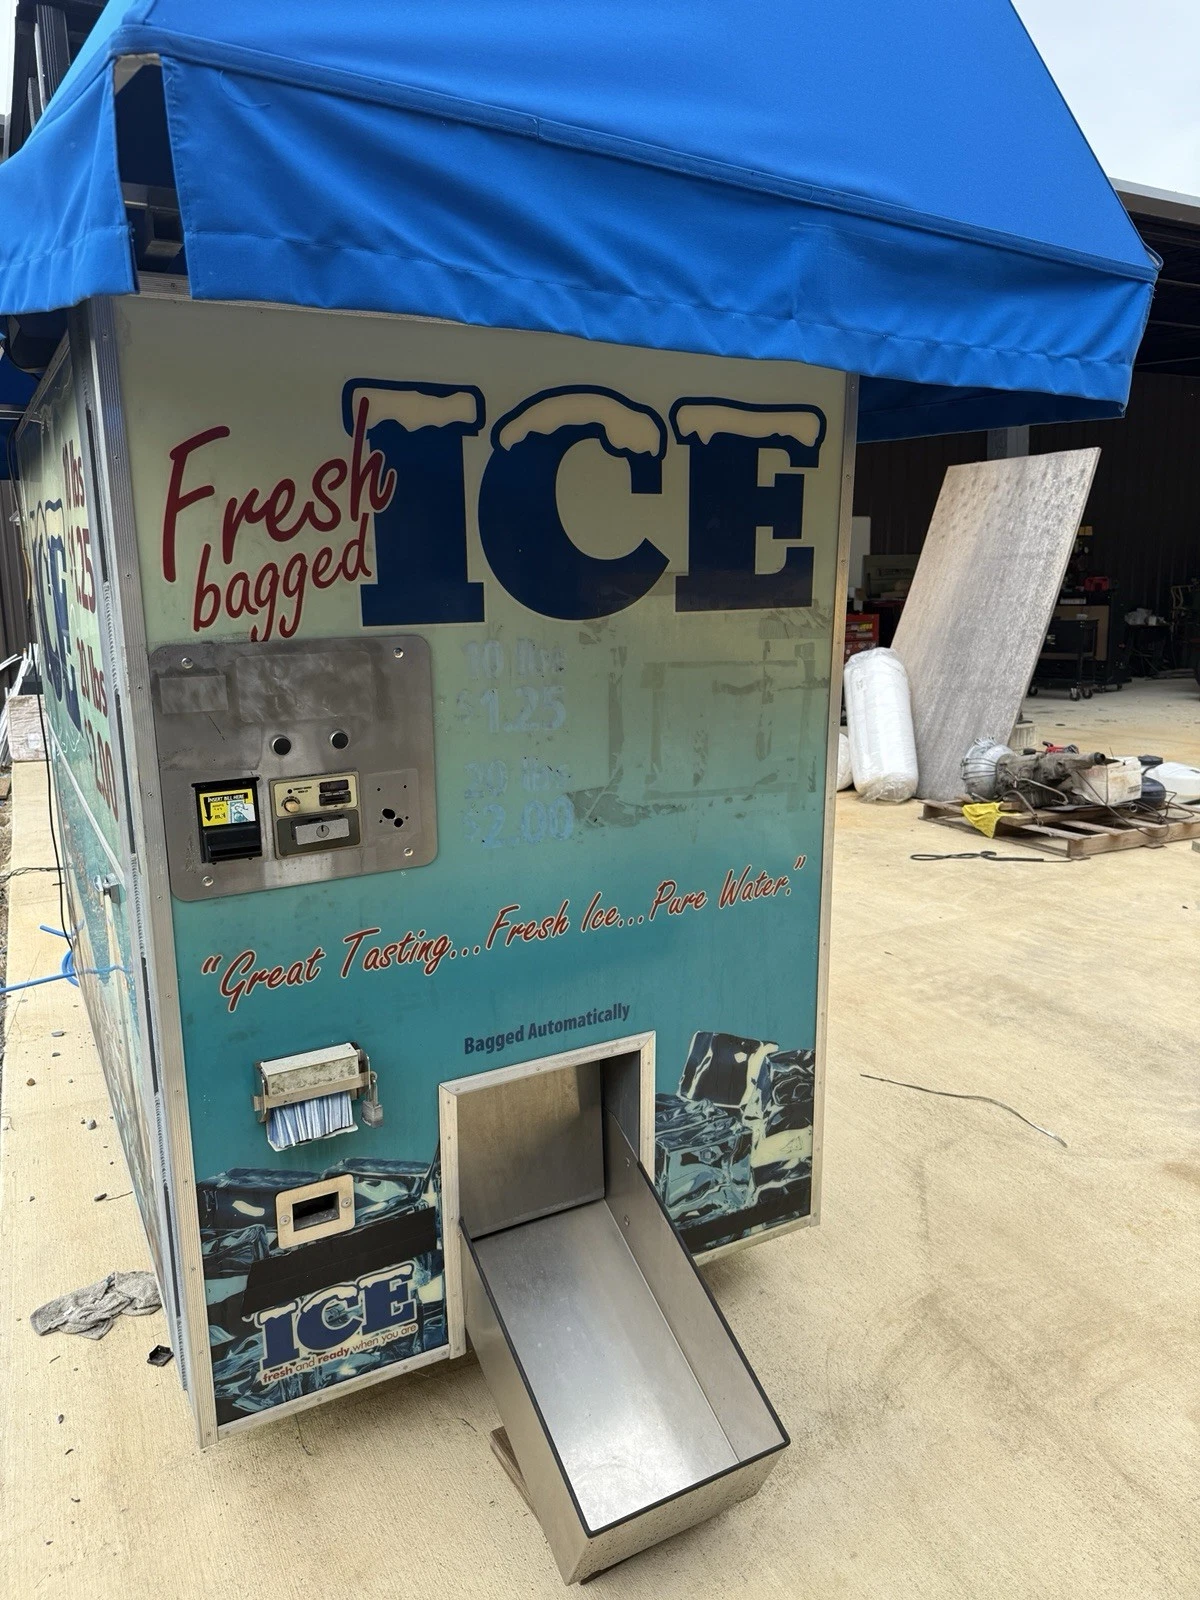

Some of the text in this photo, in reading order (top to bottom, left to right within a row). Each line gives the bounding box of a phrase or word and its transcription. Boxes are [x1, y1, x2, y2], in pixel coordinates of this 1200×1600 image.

[163, 396, 397, 583] Fresh
[341, 376, 827, 627] ICE
[193, 512, 373, 642] bagged
[464, 1002, 631, 1055] Bagged Automatically
[255, 1260, 418, 1370] ICE
[262, 1323, 417, 1384] fresh and ready when you are
